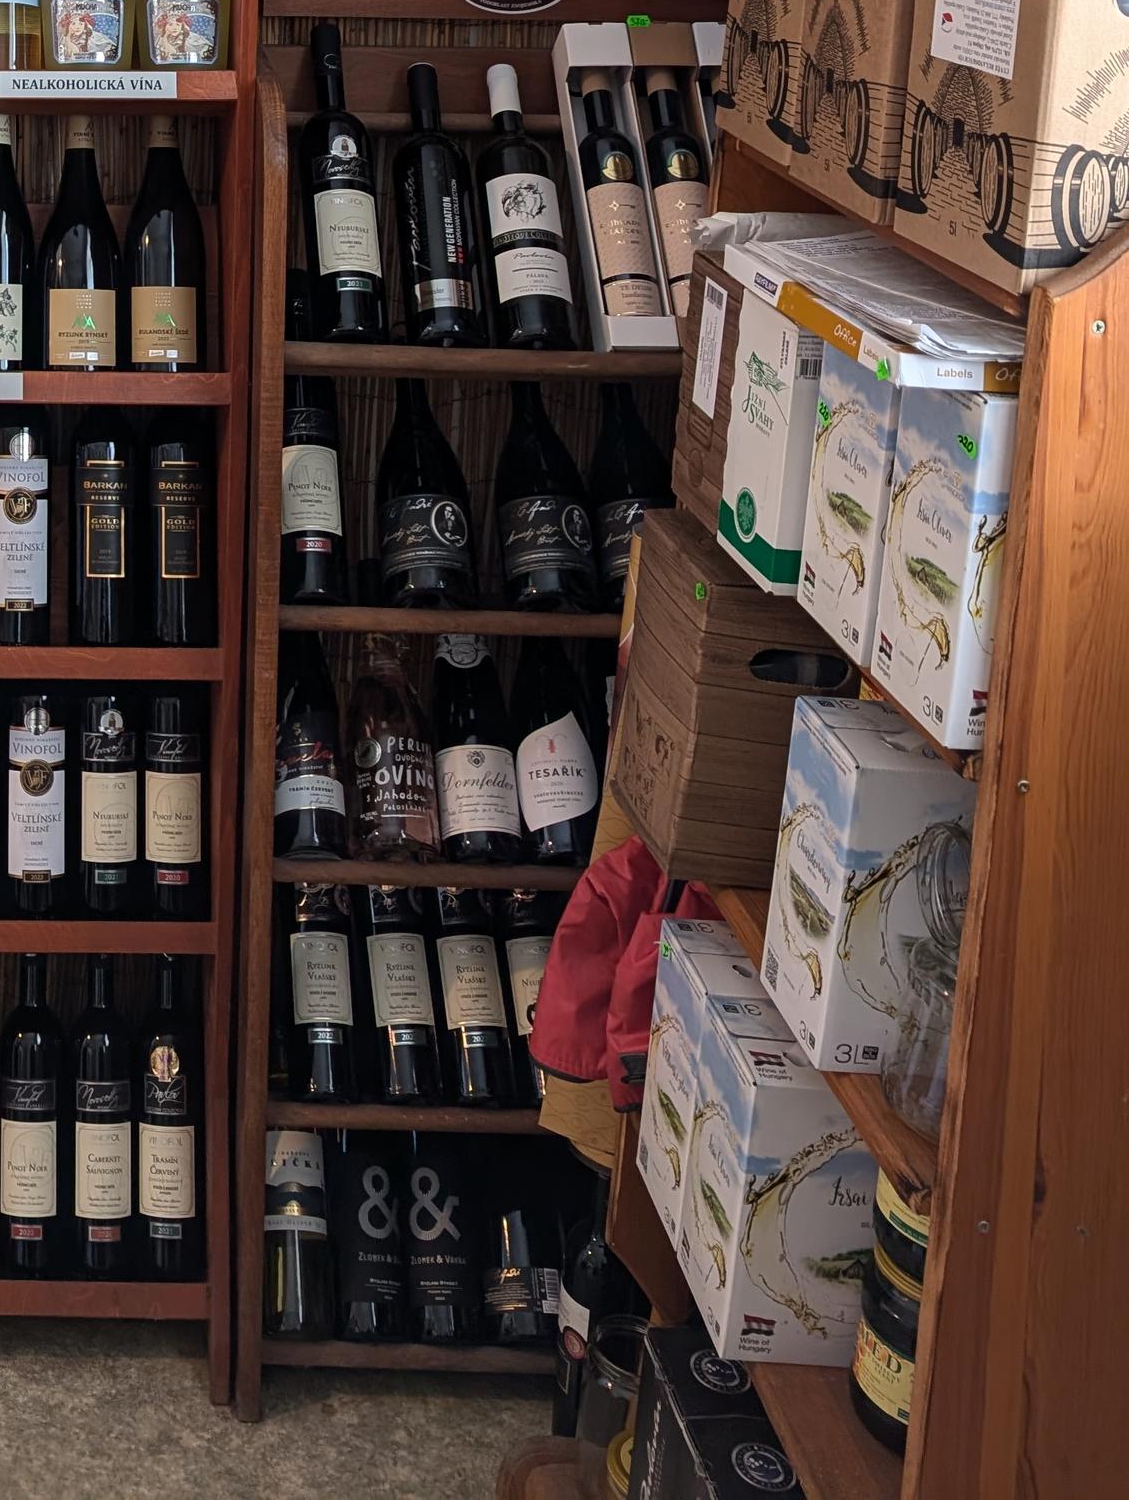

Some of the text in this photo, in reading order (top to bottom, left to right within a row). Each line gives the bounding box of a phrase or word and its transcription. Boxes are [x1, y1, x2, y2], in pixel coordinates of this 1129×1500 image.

[12, 76, 162, 90] NEALKOHOLICKÁ VÍNA
[834, 324, 856, 347] Office
[937, 368, 973, 378] Labels
[83, 480, 127, 490] BARKAN
[7, 553, 33, 561] ZELENÉ
[13, 742, 62, 755] VINOFOL
[528, 764, 584, 780] TESAŘÍK
[444, 772, 515, 793] Dornfelder
[12, 811, 62, 823] VELTLÍNSKÉ
[24, 824, 49, 833] ZELENÉ
